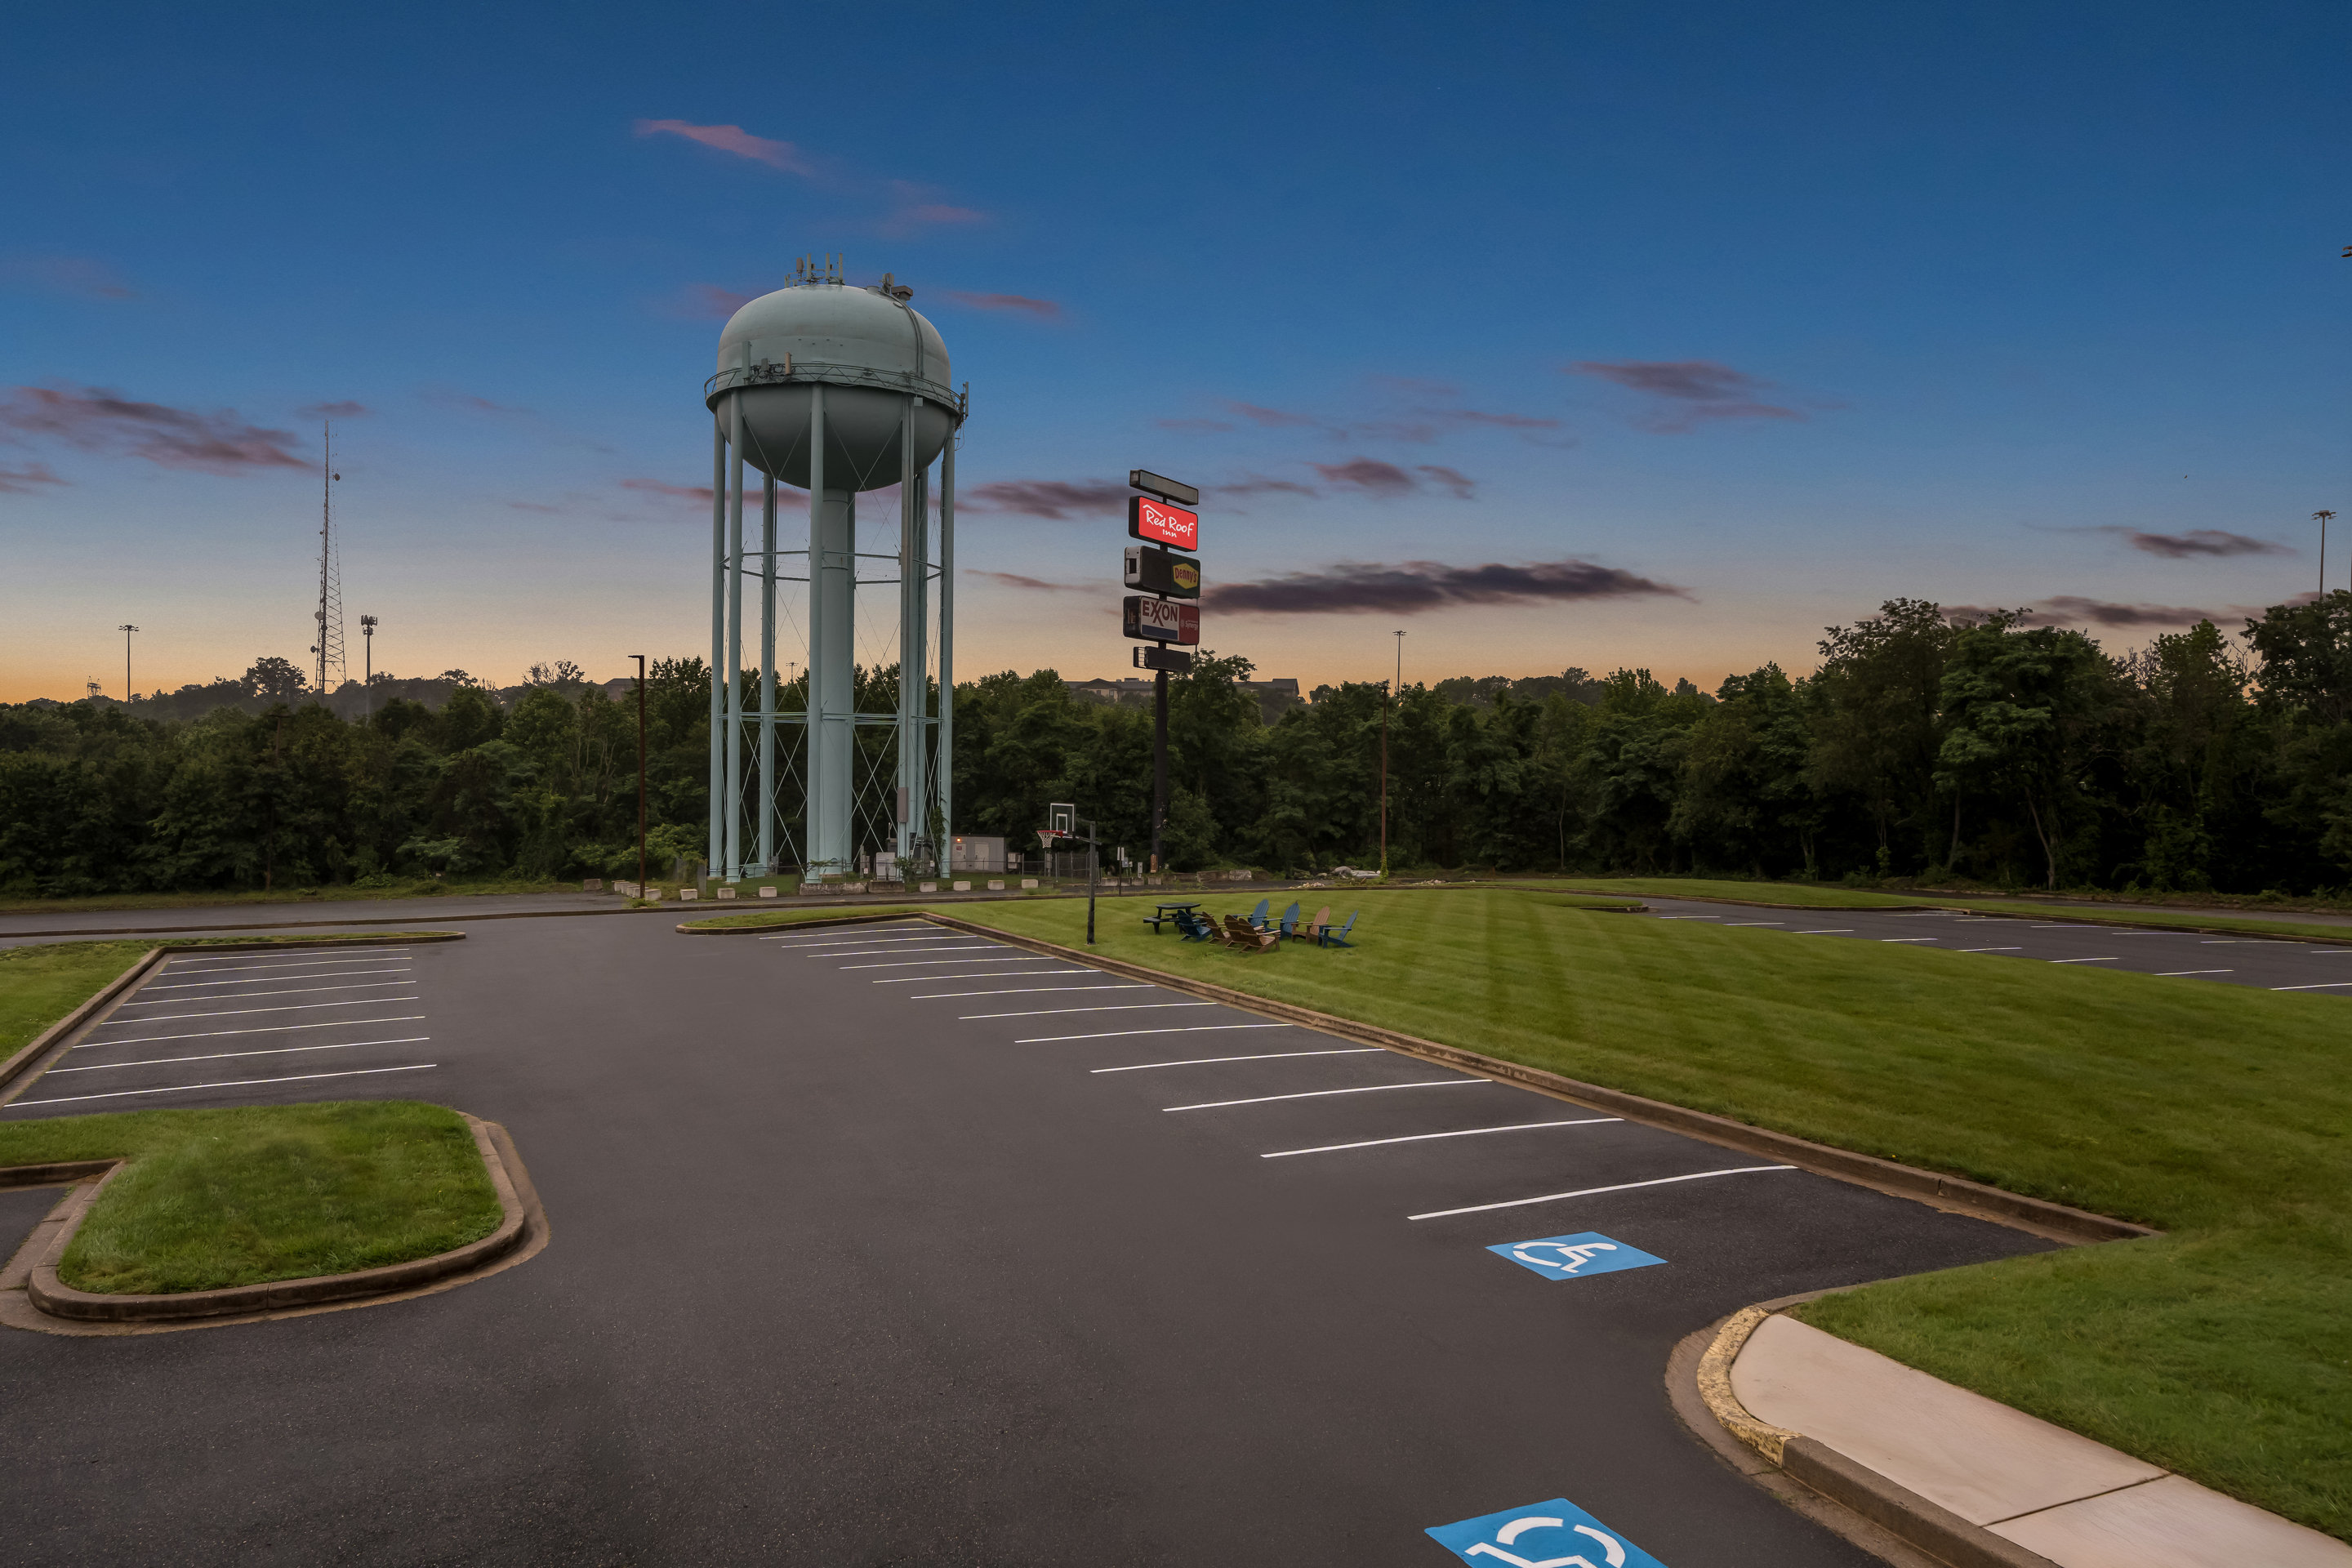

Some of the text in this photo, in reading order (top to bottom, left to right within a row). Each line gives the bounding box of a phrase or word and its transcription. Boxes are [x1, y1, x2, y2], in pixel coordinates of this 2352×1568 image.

[1146, 510, 1194, 537] Red Roof
[1174, 567, 1197, 583] Denny's
[1143, 600, 1178, 626] EXXON
